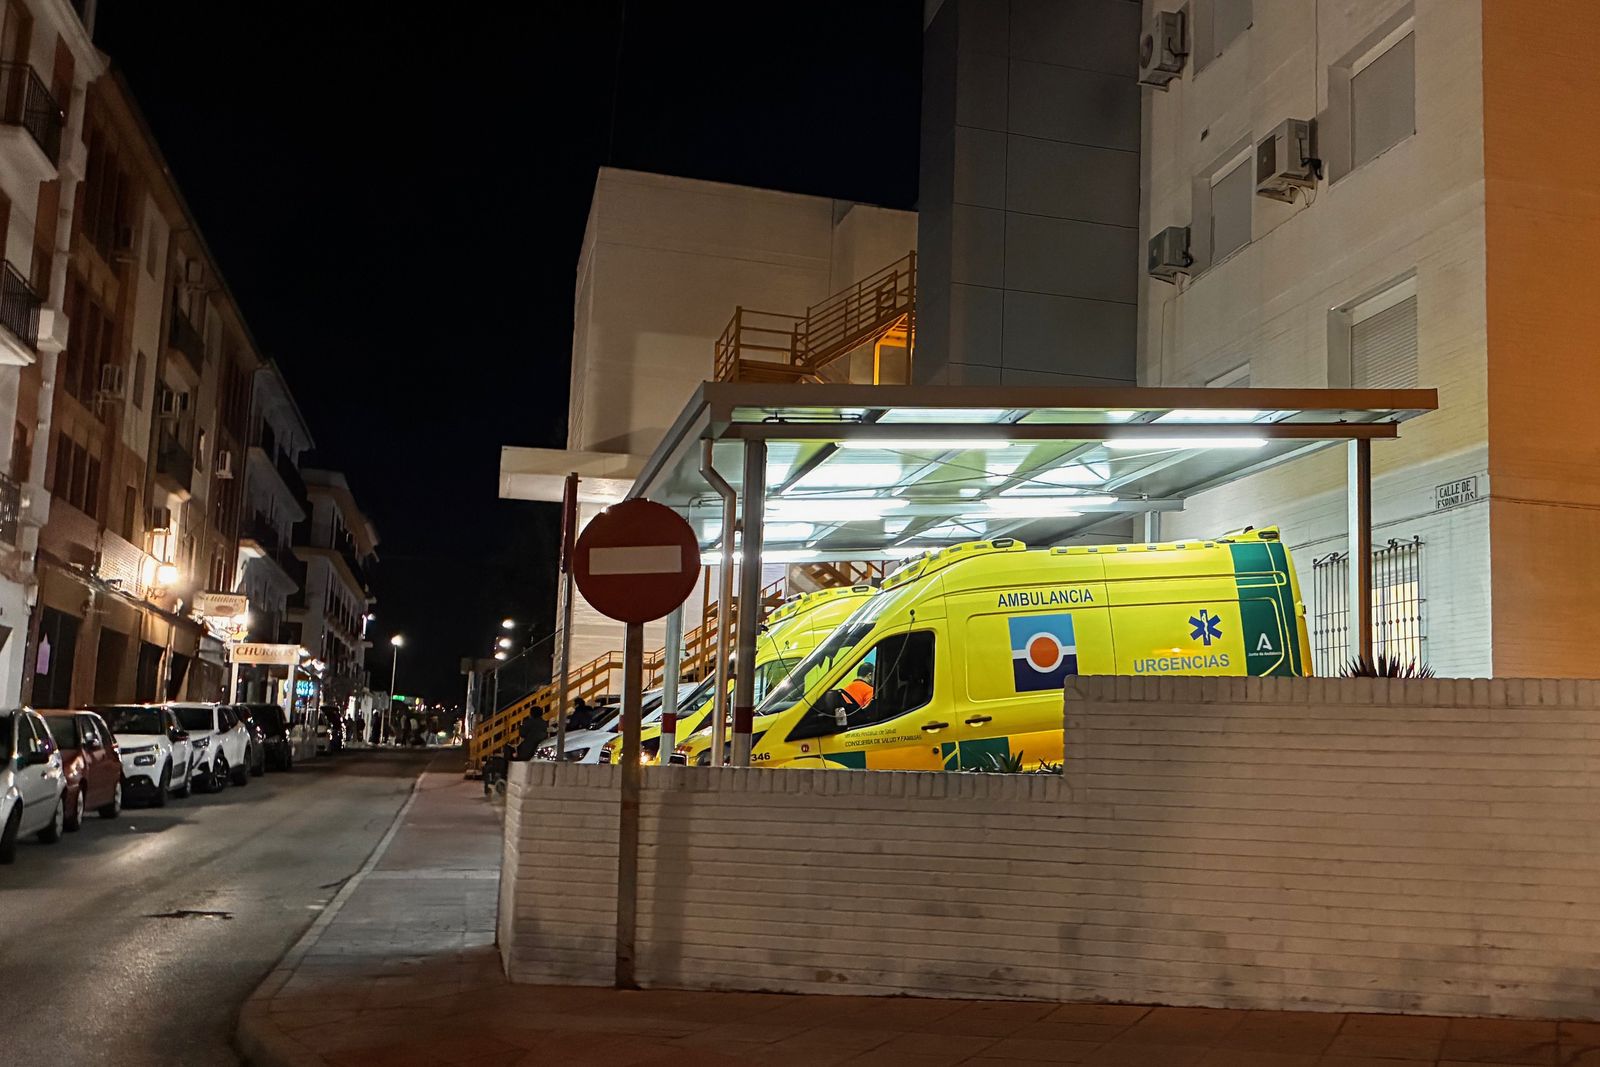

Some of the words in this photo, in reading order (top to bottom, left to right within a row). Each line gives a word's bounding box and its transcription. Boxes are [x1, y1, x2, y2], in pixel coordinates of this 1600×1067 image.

[1440, 483, 1460, 498] CALLE
[1461, 480, 1471, 492] DE
[998, 589, 1094, 608] AMBULANCIA
[236, 646, 295, 657] CHURROS
[1133, 653, 1230, 673] URGENCIAS
[751, 752, 771, 762] 346
